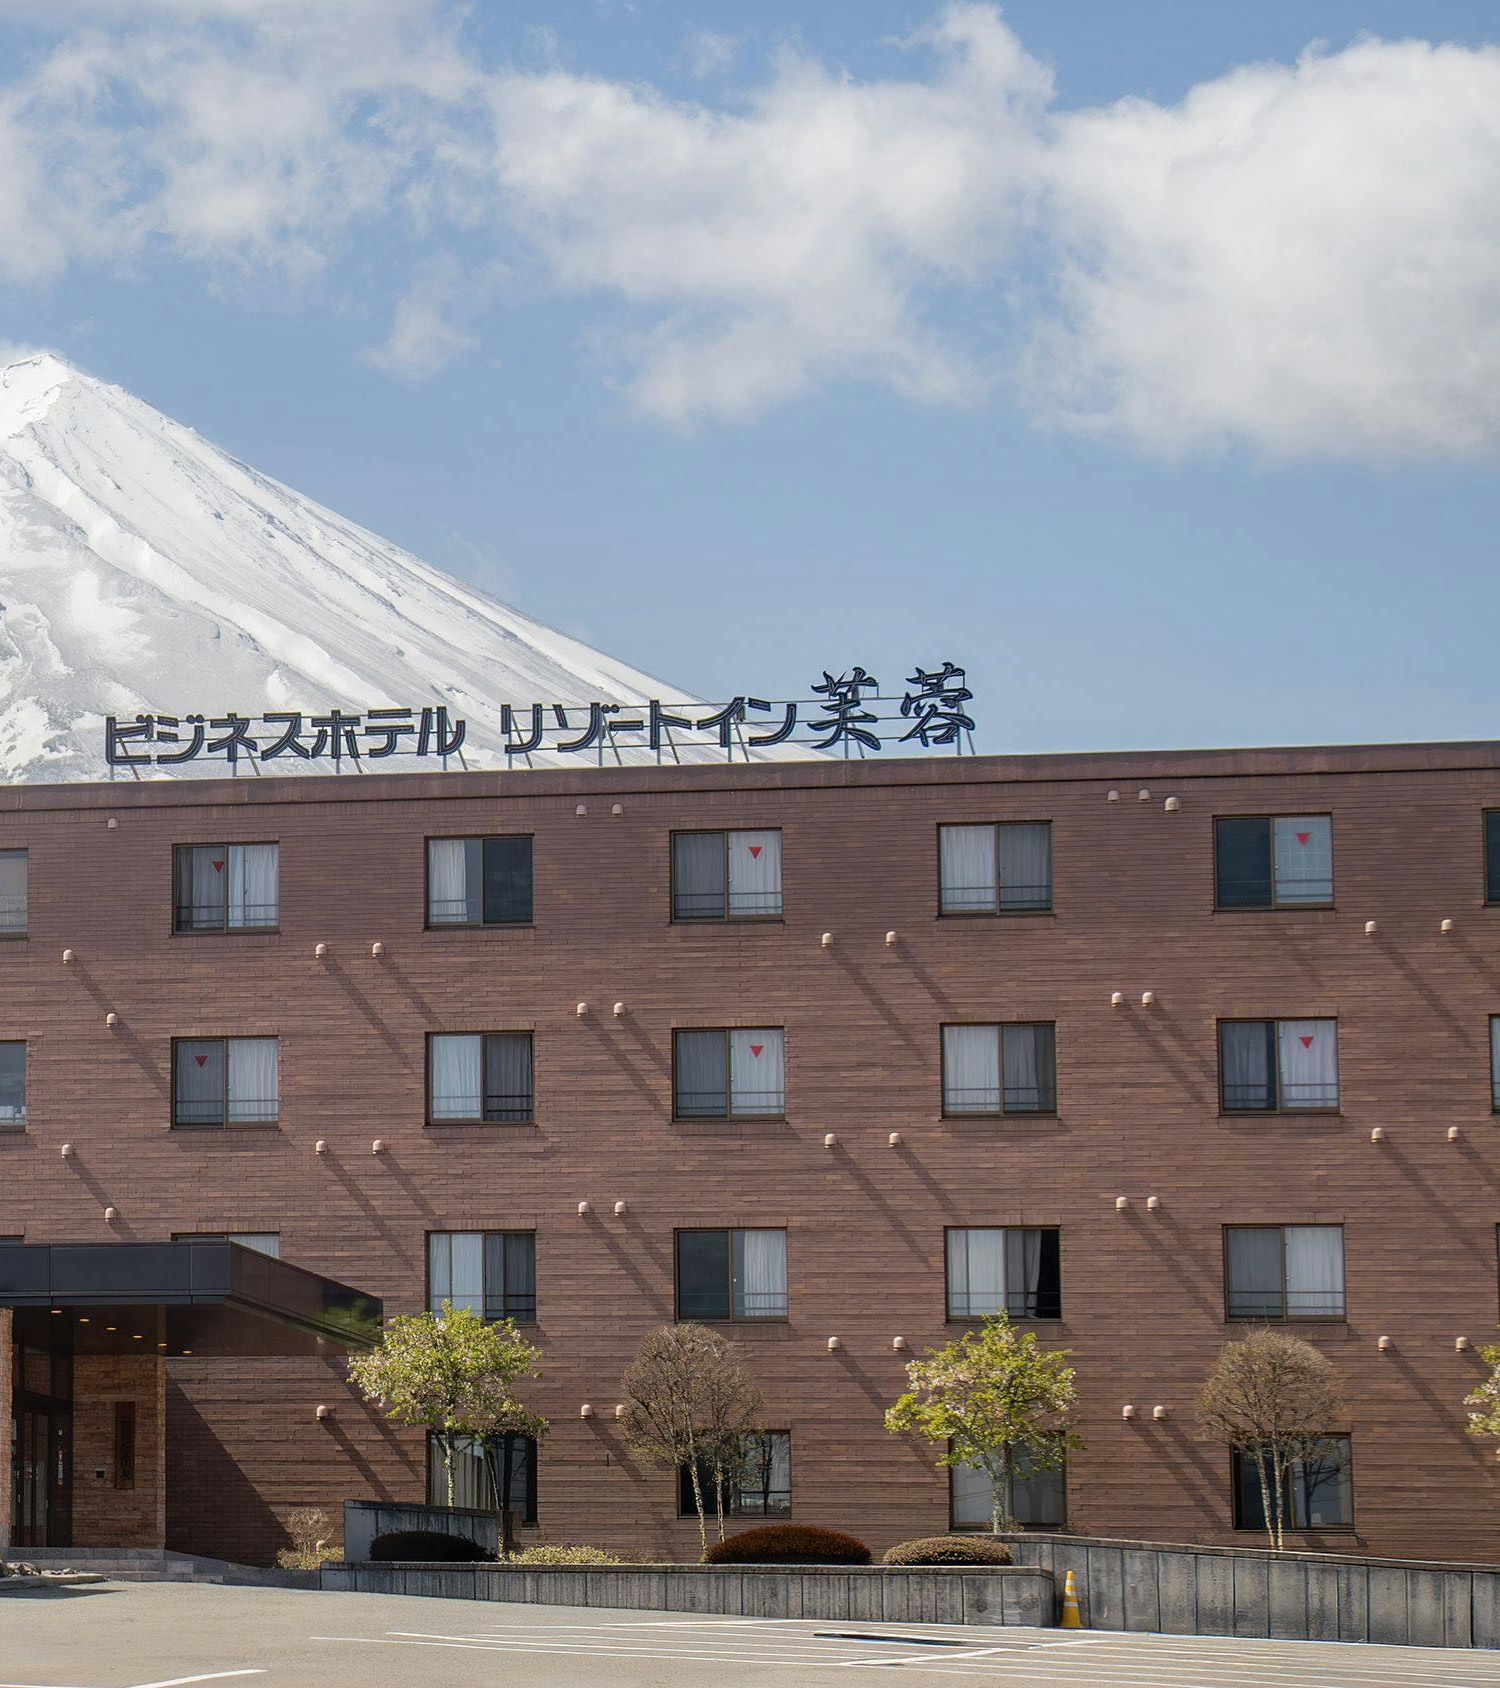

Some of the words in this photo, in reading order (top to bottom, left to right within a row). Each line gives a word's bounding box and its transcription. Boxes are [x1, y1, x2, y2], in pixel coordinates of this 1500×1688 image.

[105, 706, 466, 765] ビジネスホテル
